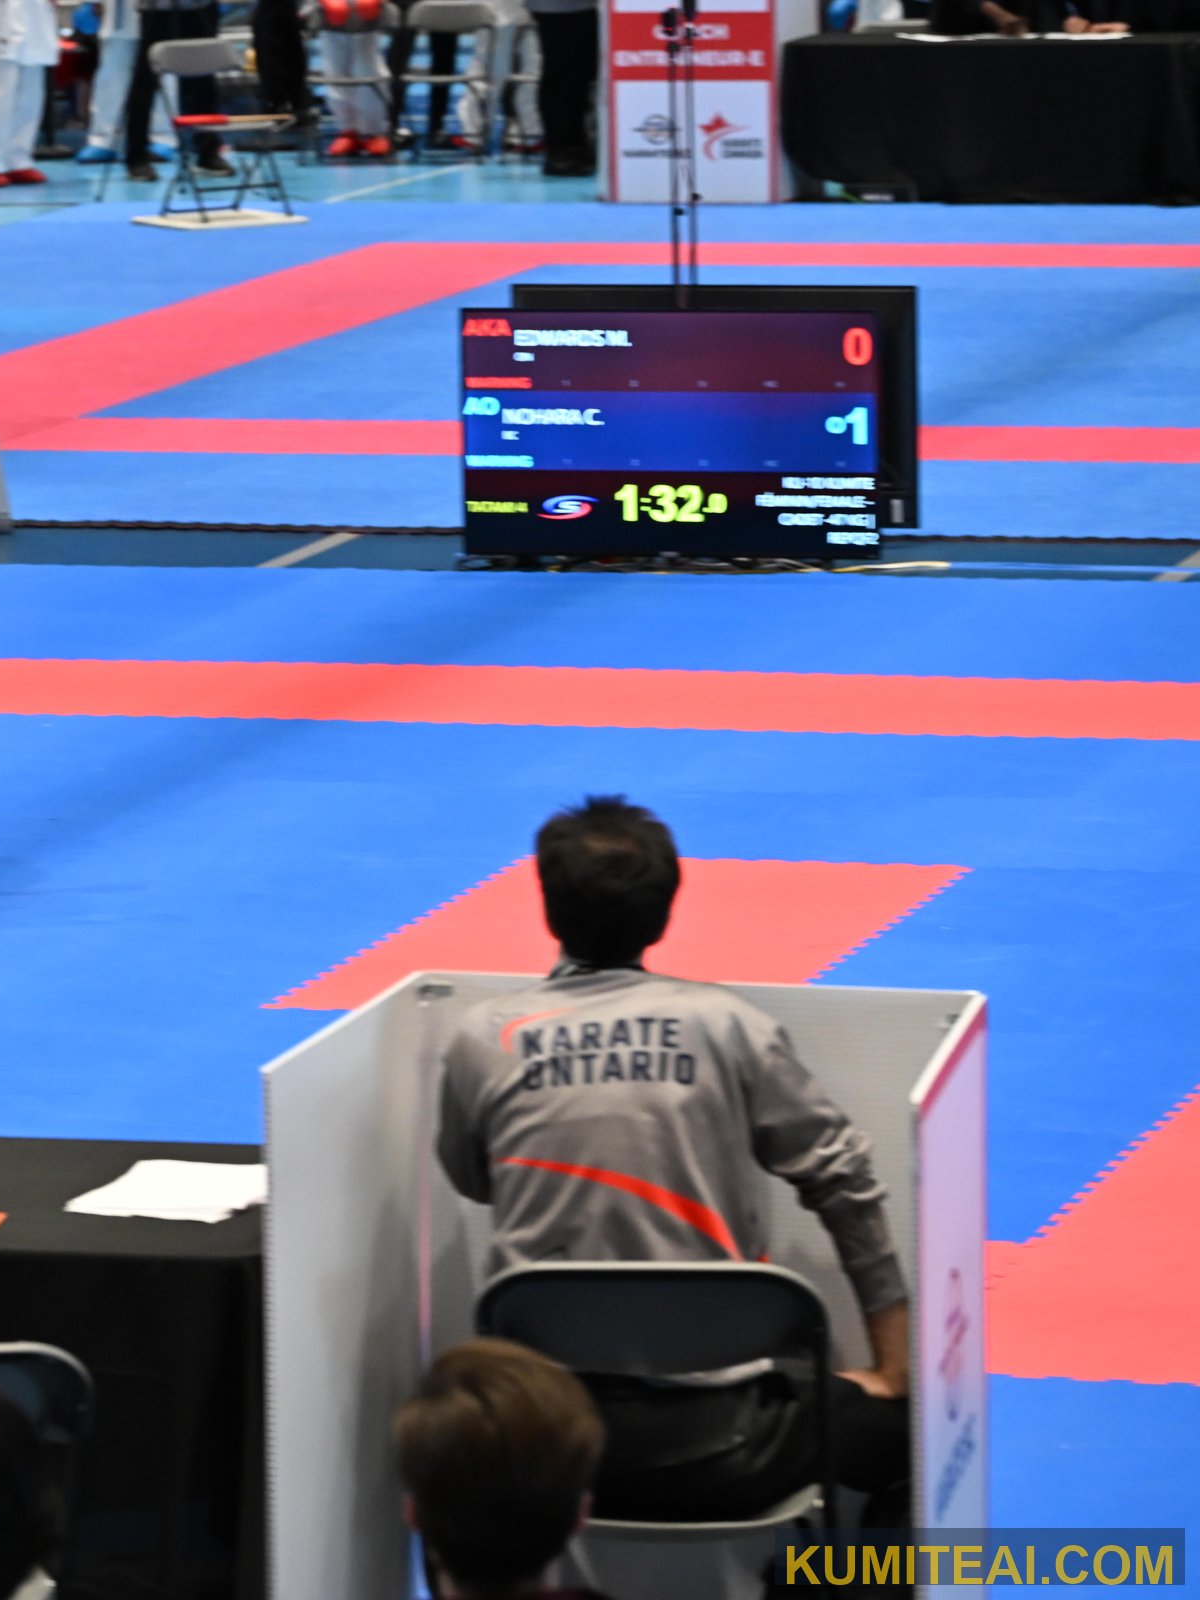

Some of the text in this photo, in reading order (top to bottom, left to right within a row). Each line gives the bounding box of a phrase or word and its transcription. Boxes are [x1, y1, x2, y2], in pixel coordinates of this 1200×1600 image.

[843, 327, 873, 366] 0
[520, 1017, 680, 1059] KARATE
[522, 1051, 695, 1091] ONTARIO
